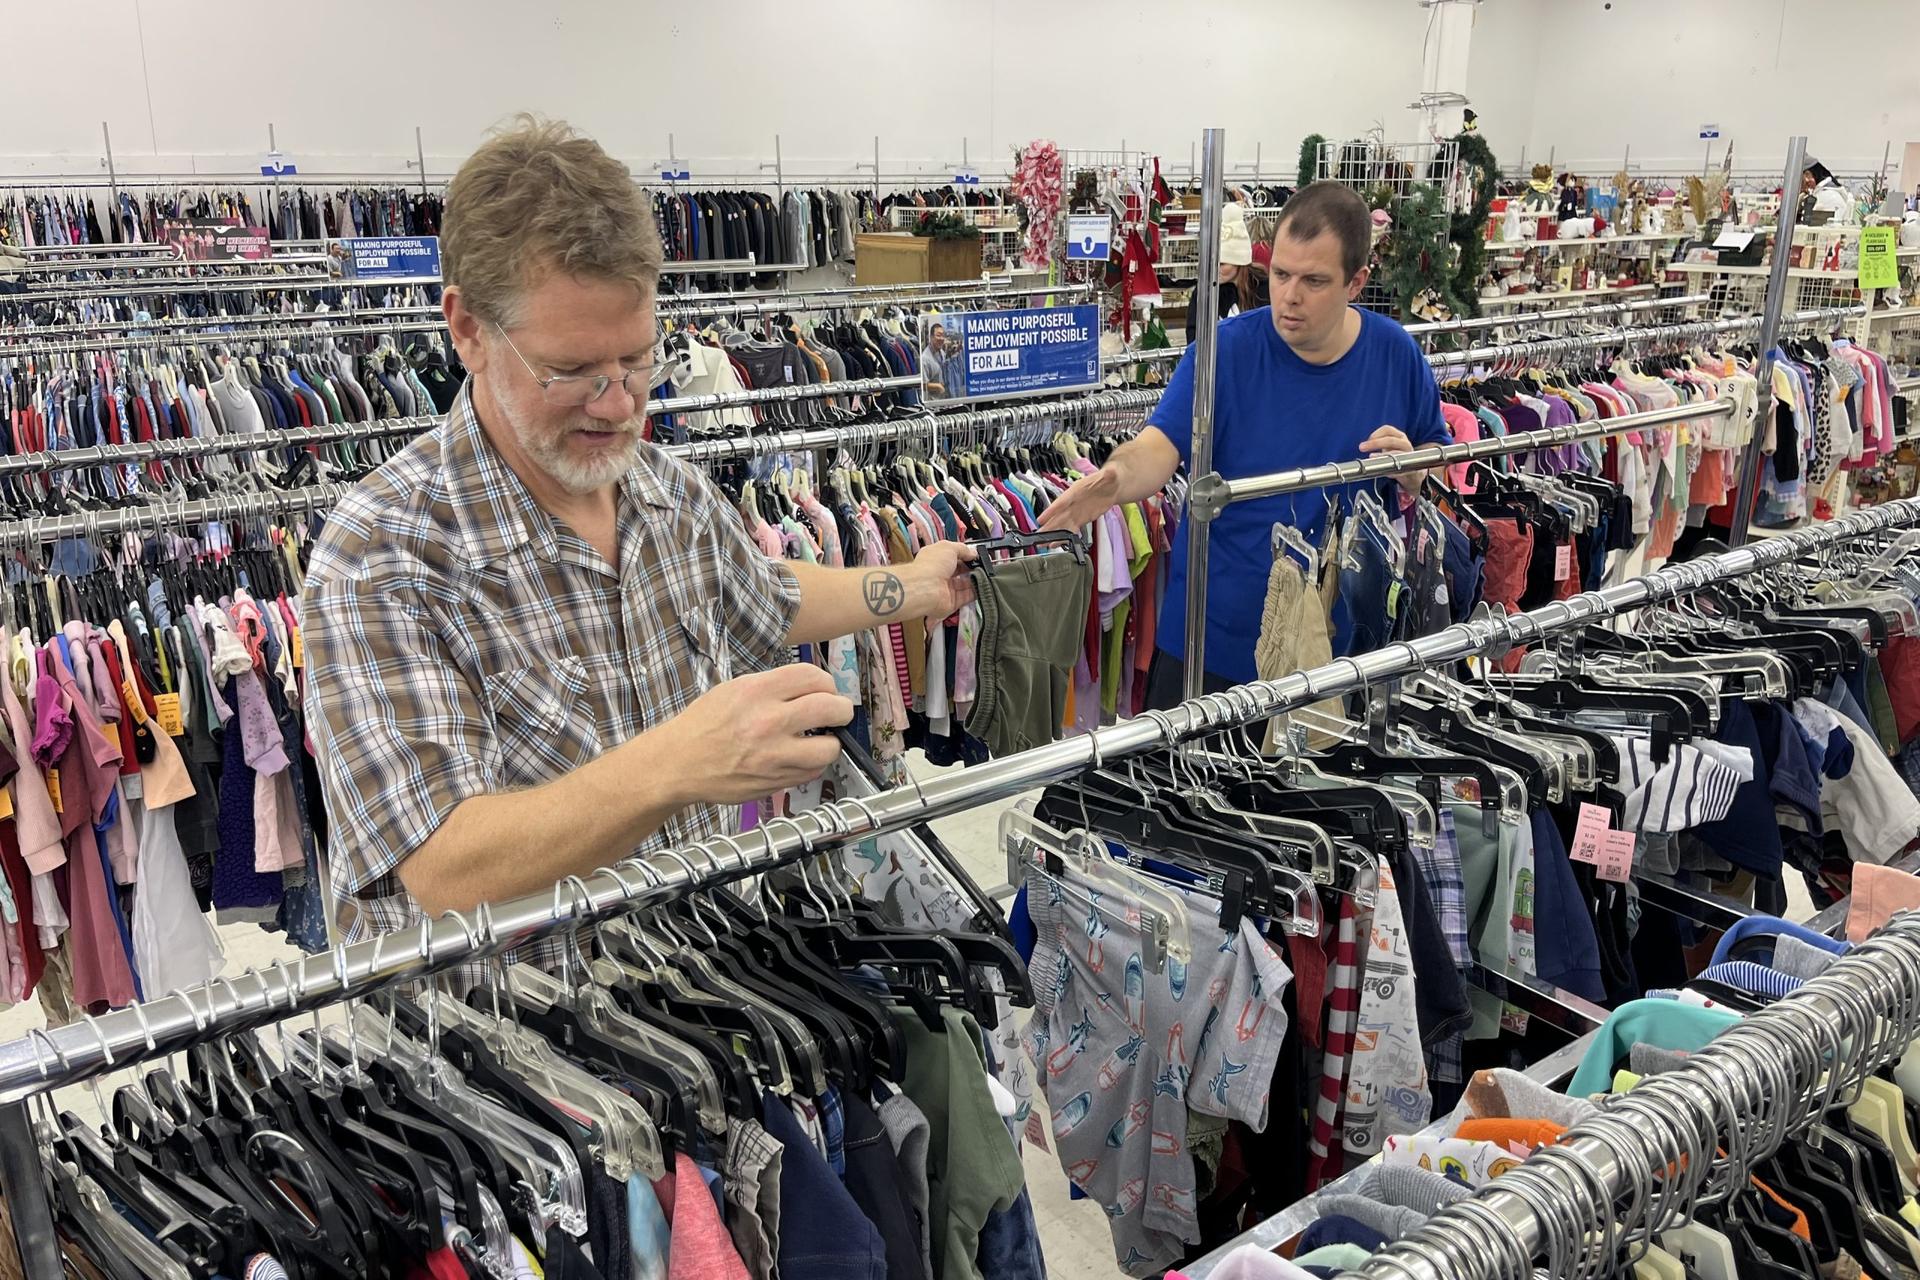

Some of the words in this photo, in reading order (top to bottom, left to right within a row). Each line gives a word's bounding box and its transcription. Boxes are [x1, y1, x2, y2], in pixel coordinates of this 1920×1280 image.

[382, 240, 423, 249] PURPOSEFUL
[354, 248, 400, 257] EMPLOYMENT
[400, 248, 431, 256] POSSIBLE
[358, 258, 371, 267] FOR
[373, 258, 387, 267] ALL.
[967, 318, 1010, 334] MAKING
[1012, 312, 1076, 330] PURPOSEFUL
[968, 332, 1039, 351] EMPLOYMENT
[1041, 327, 1088, 344] POSSIBLE
[972, 355, 993, 370] FOR
[995, 353, 1018, 368] ALL.
[1727, 383, 1735, 393] S
